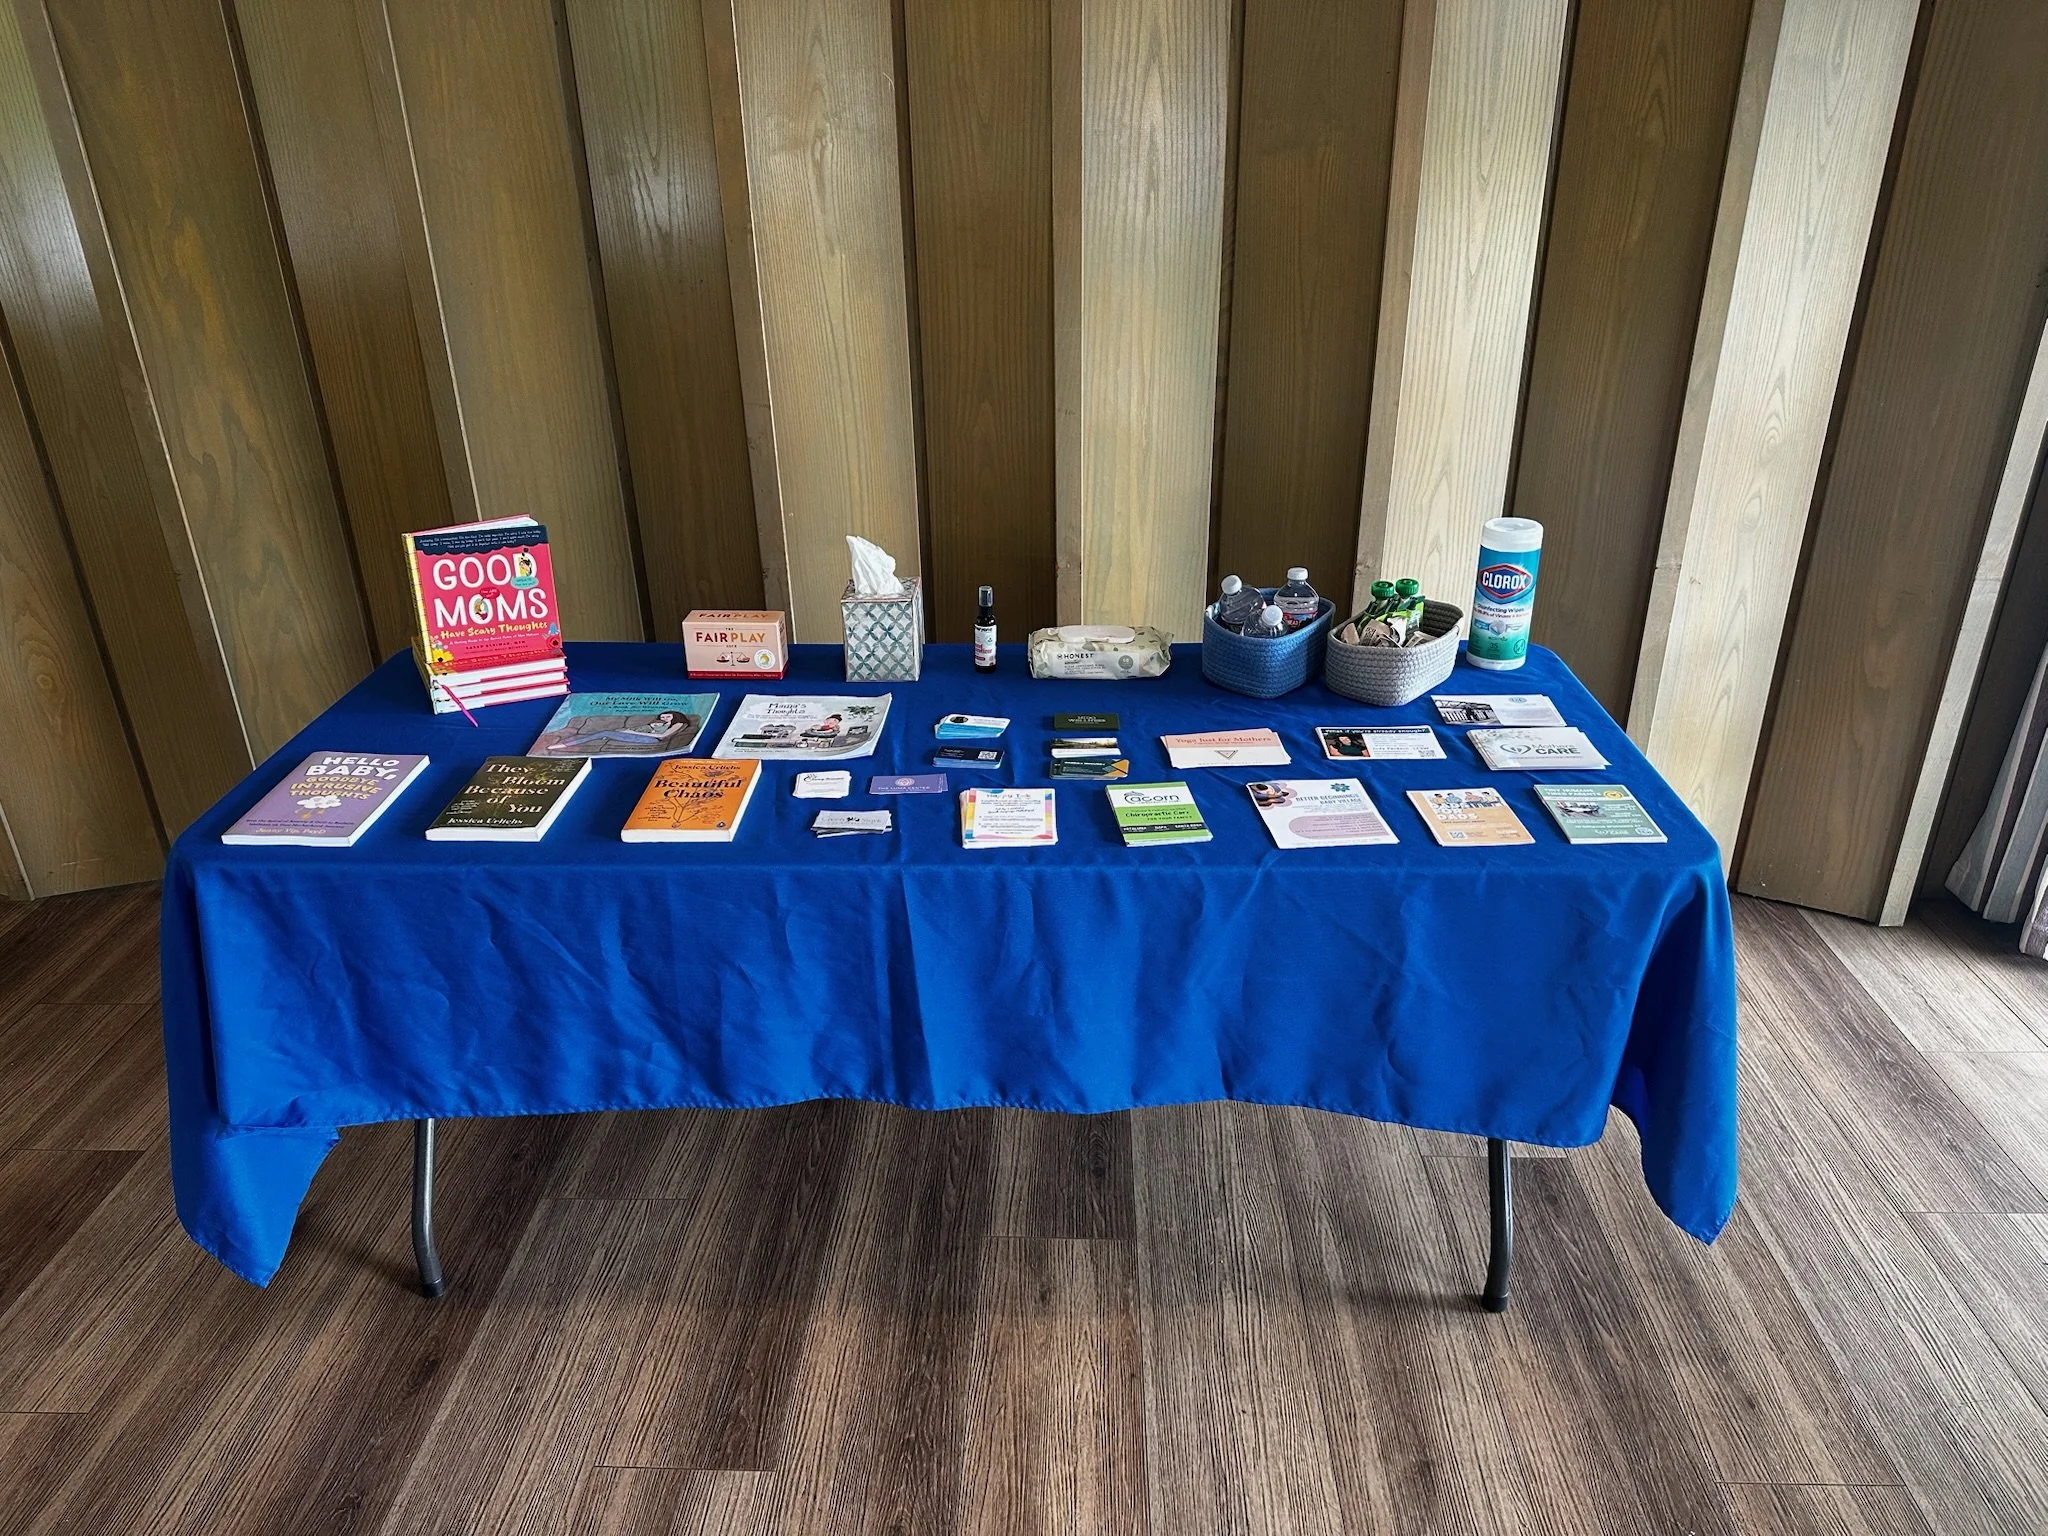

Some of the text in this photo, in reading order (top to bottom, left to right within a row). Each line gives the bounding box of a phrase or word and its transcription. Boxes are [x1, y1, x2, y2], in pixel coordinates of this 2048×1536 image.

[432, 552, 538, 591] GOOD
[1482, 571, 1528, 590] CLOROX
[433, 588, 549, 629] MOMS
[440, 621, 548, 640] Have Scary Thoughts
[695, 632, 766, 643] FAIR PLAY
[1535, 747, 1581, 755] CARE
[322, 756, 400, 767] HELLO
[305, 765, 400, 780] BABY,
[486, 764, 533, 774] They
[306, 776, 380, 786] GOODBYE
[501, 776, 566, 786] Bloom
[654, 779, 743, 788] Beautiful
[290, 783, 383, 794] INTRUSIVE
[463, 785, 550, 795] Because
[289, 790, 372, 800] THOUGHTS
[663, 789, 724, 799] Chaos
[1126, 794, 1180, 802] acorn
[486, 795, 510, 804] of
[508, 804, 543, 813] You
[447, 817, 484, 825] Jessica
